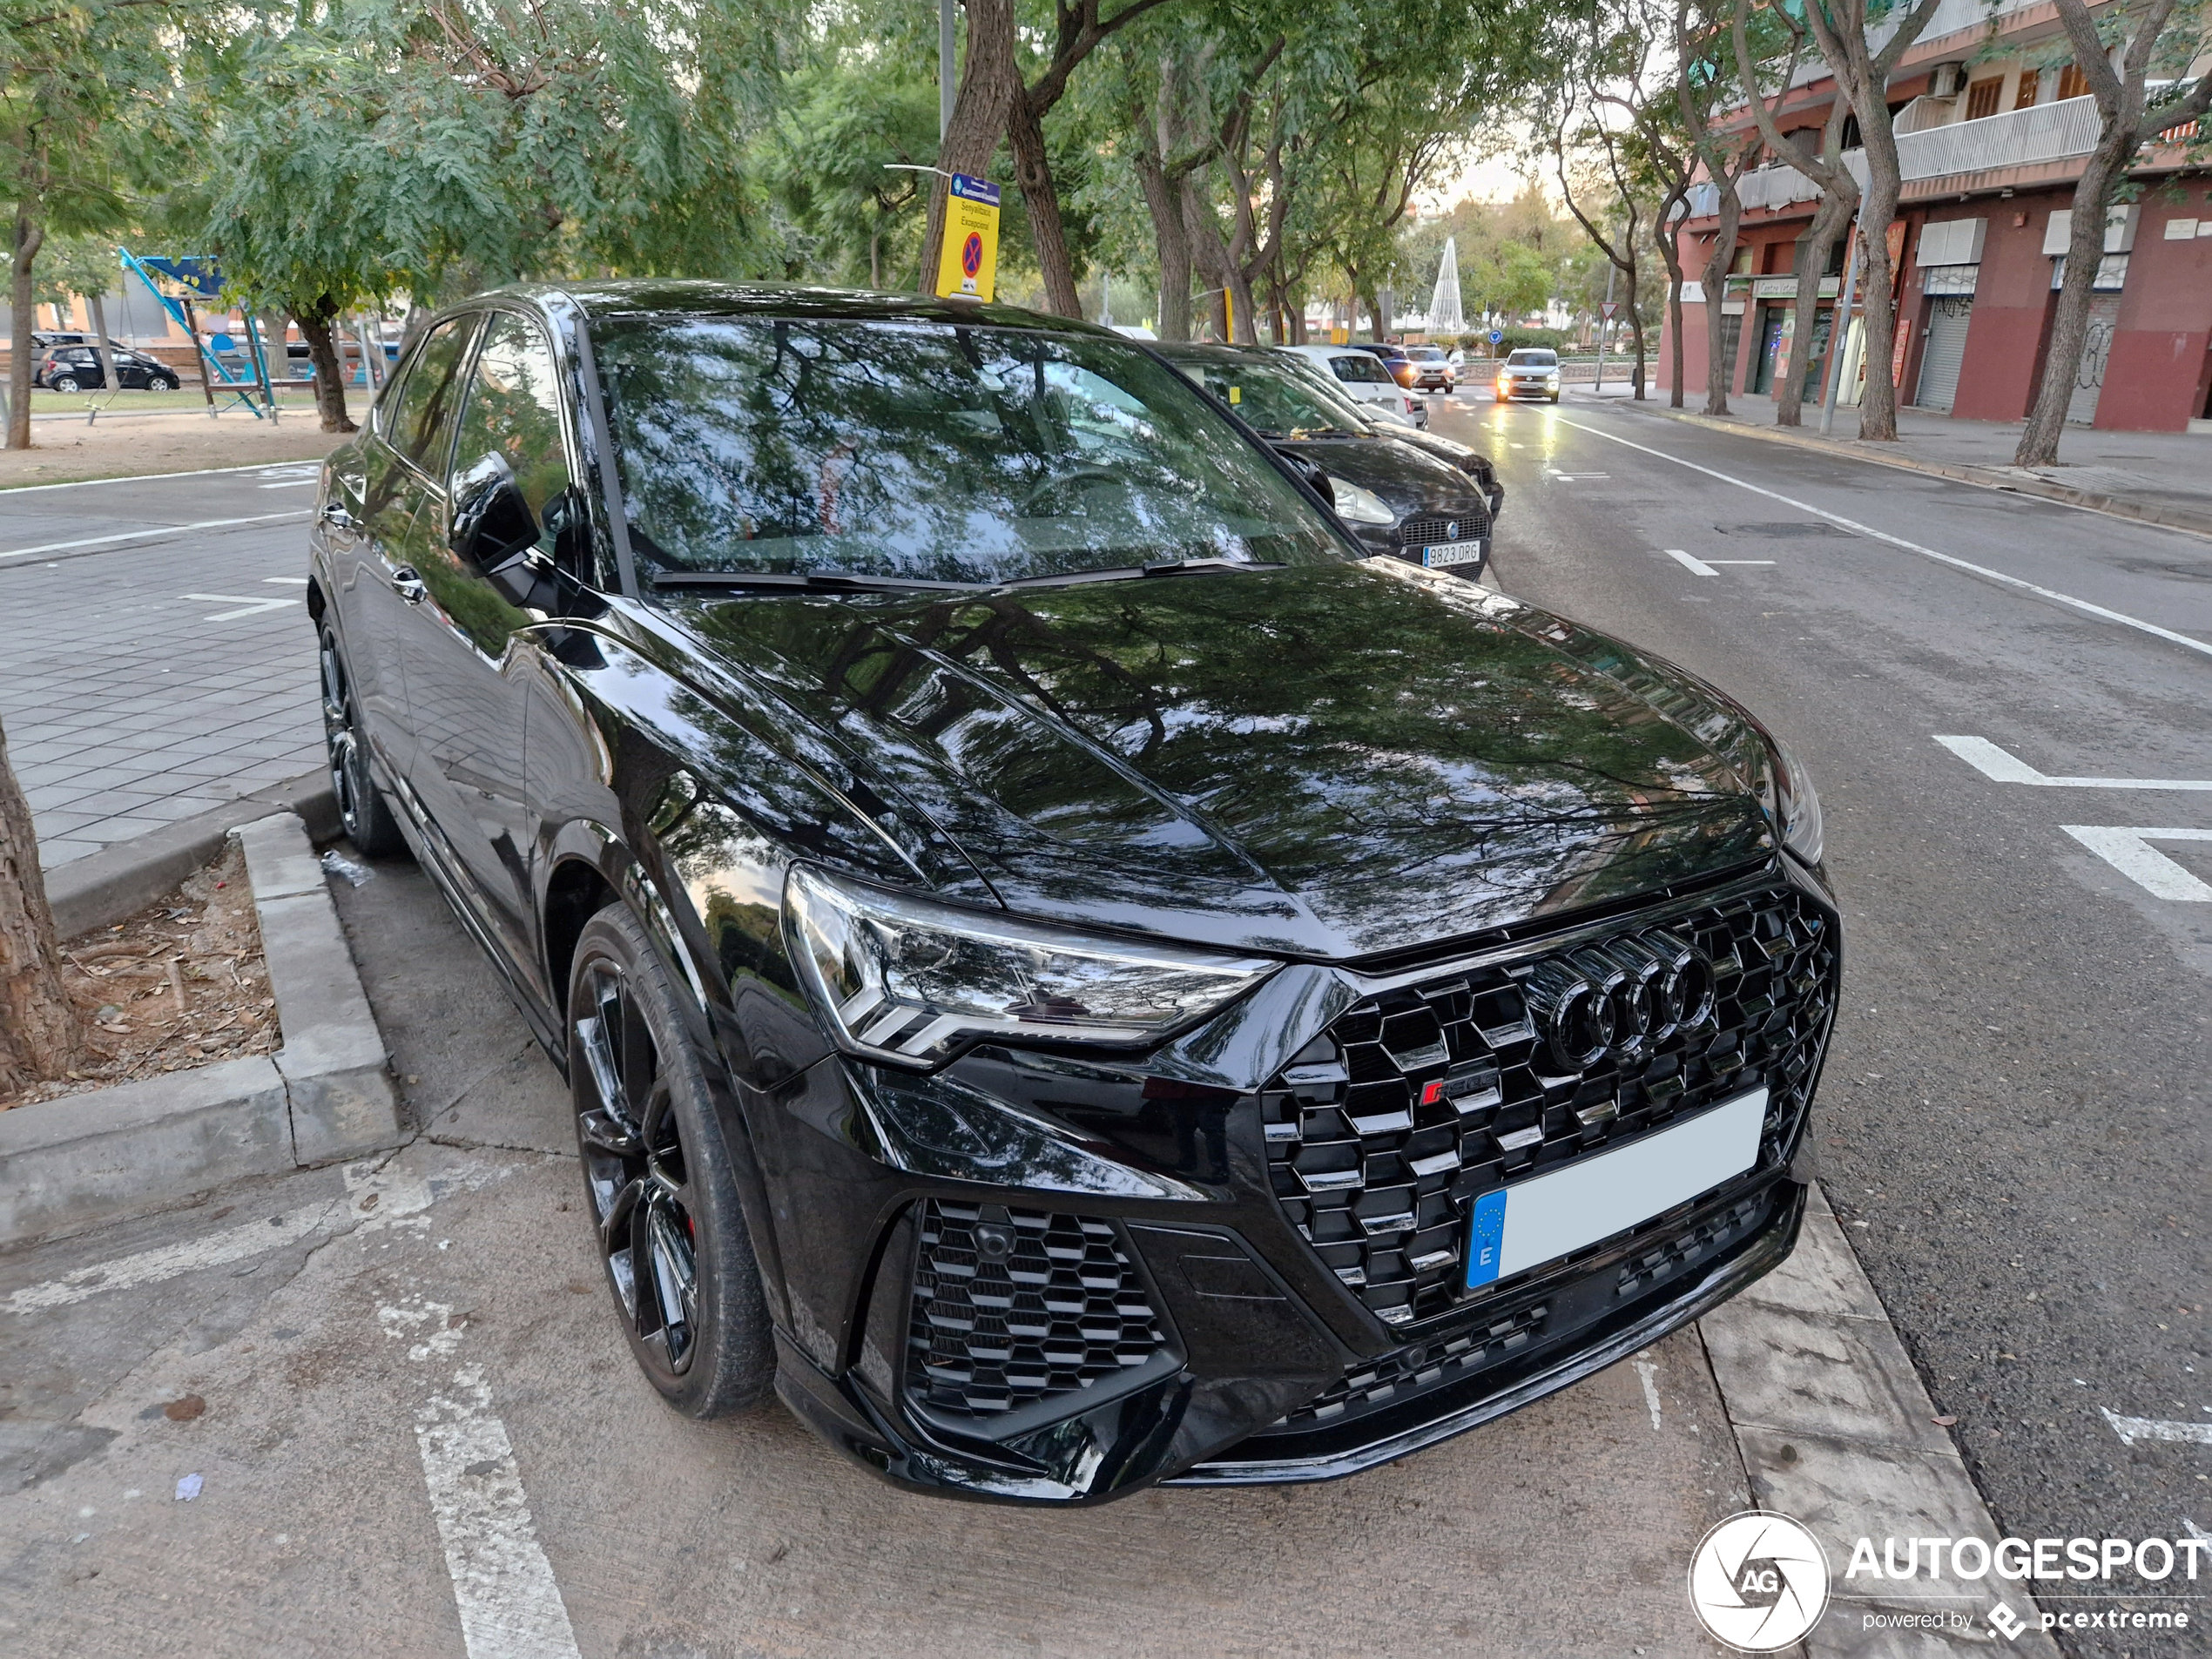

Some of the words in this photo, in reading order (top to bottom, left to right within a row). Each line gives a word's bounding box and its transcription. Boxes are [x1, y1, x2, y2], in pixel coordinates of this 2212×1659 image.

[961, 216, 990, 230] Excepcional
[1430, 546, 1456, 564] 9823
[1459, 544, 1477, 561] DRG
[1480, 1246, 1494, 1266] E
